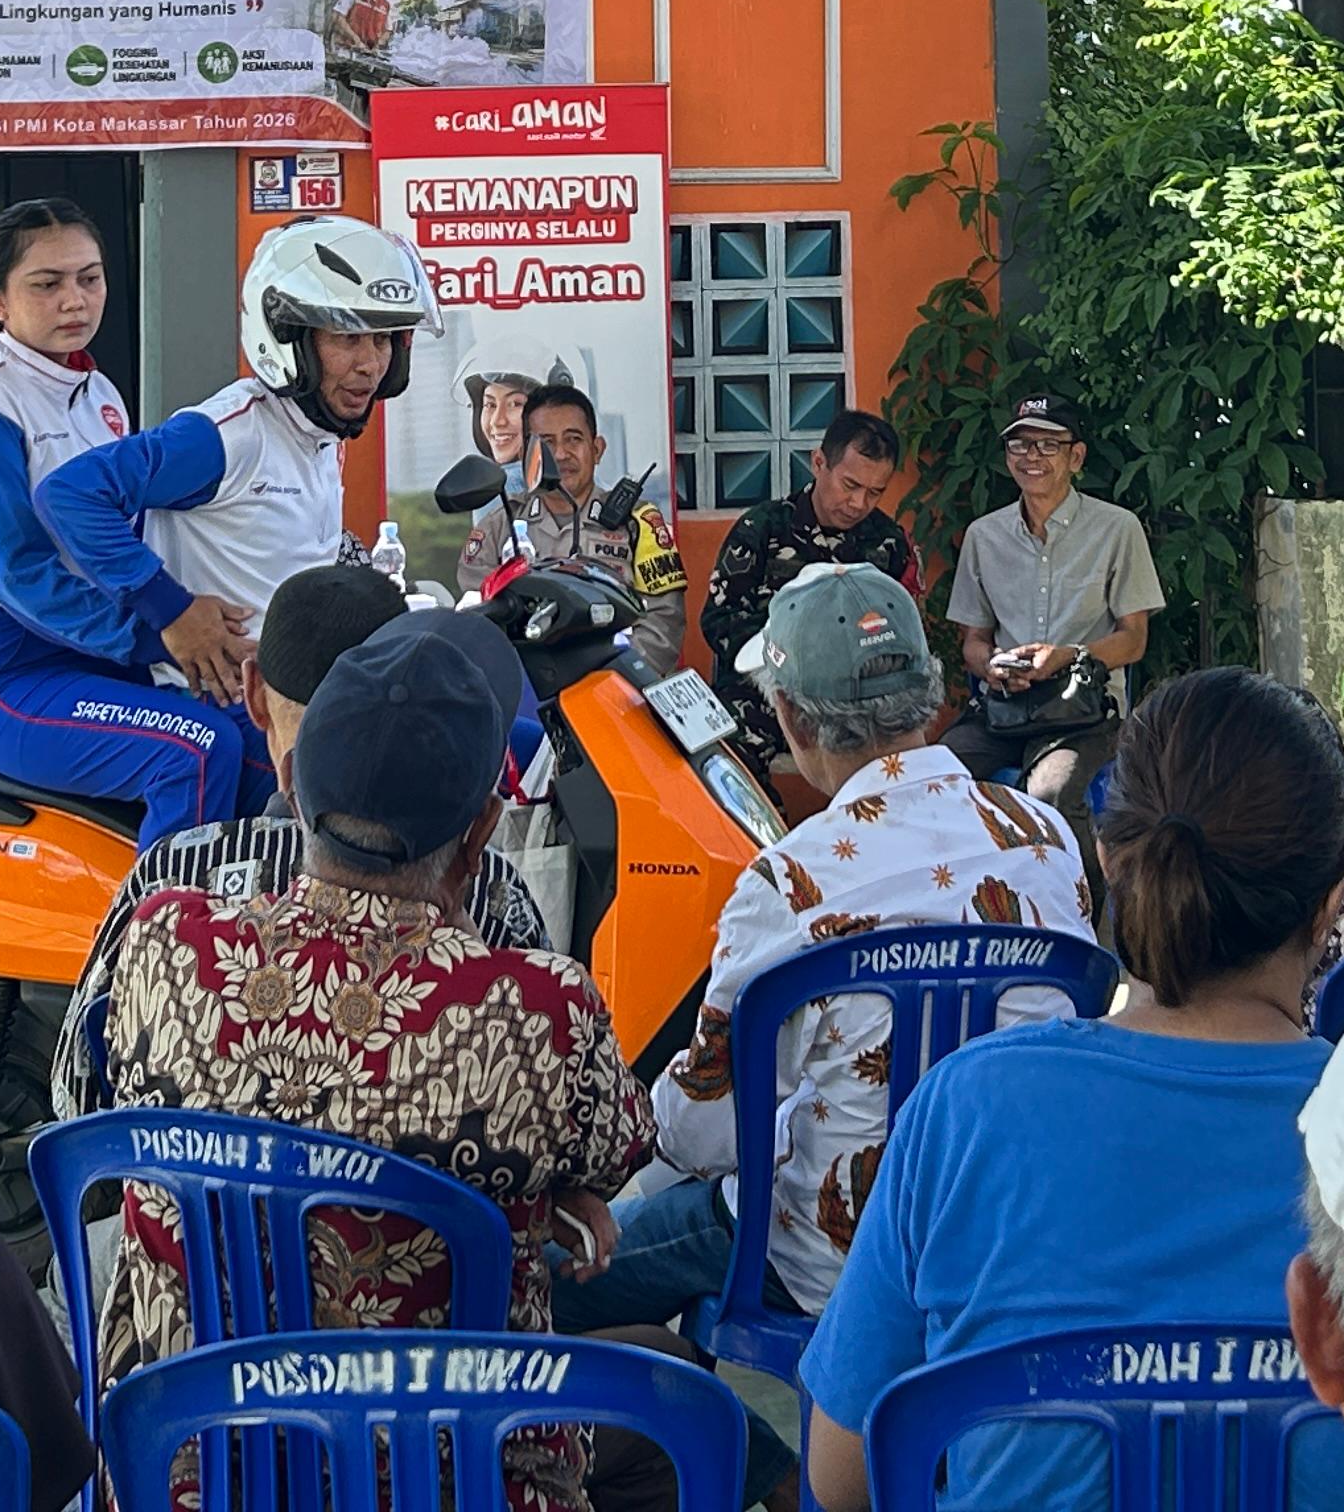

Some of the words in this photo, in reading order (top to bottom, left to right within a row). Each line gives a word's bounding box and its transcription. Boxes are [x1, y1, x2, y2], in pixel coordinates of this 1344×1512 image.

[0, 2, 104, 21] Lingkungan
[109, 4, 153, 21] yang
[158, 1, 237, 16] Humanis
[242, 50, 265, 60] AKSI
[14, 119, 47, 133] PMI
[53, 118, 95, 132] Kota
[101, 116, 187, 131] Makassar
[193, 114, 248, 129] Tahun
[253, 113, 296, 128] 2026
[297, 179, 336, 207] 156
[407, 176, 637, 216] KEMANAPUN
[430, 220, 531, 242] PERGINYA
[536, 219, 616, 240] SELALU
[377, 284, 411, 298] KYT
[72, 701, 216, 749] SAFETY-INDONESIA
[629, 862, 700, 876] HONDA
[963, 940, 977, 968] I
[255, 1135, 274, 1173] I
[289, 1140, 386, 1184] W.01
[407, 1346, 436, 1392] I
